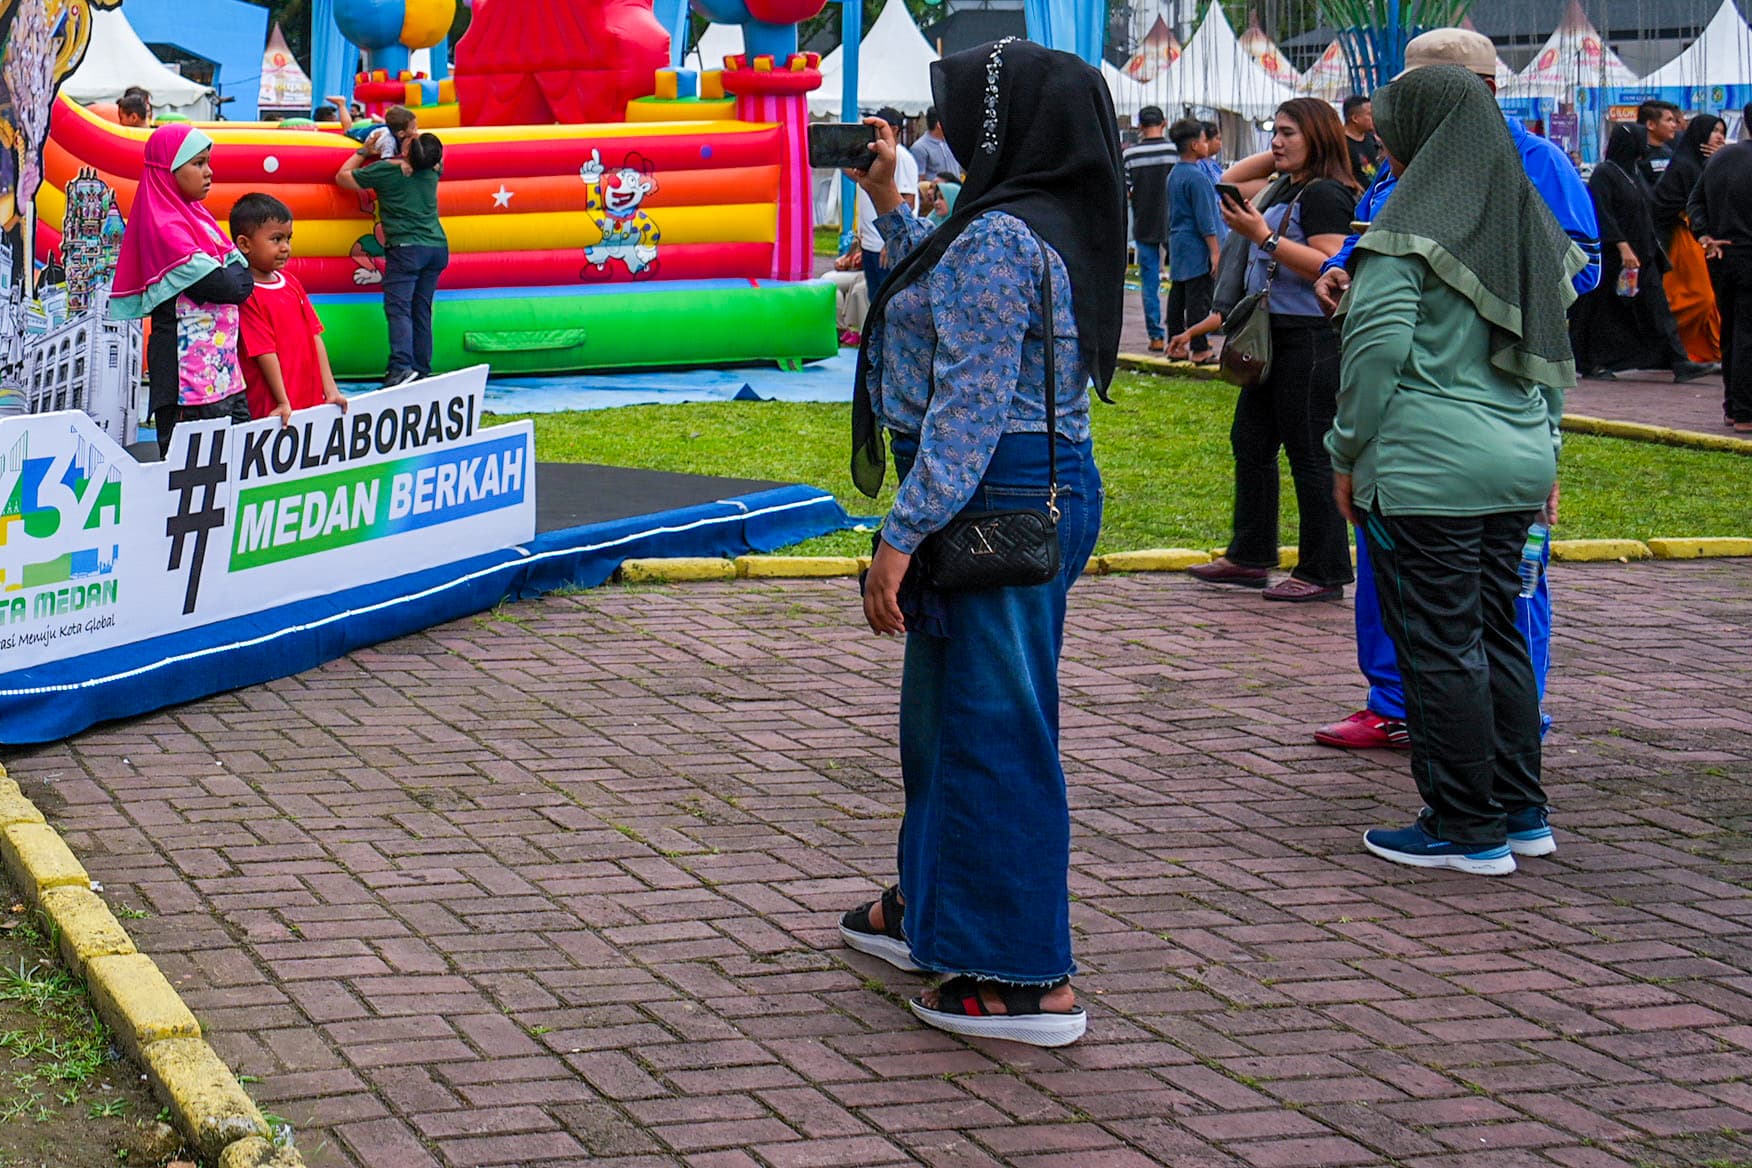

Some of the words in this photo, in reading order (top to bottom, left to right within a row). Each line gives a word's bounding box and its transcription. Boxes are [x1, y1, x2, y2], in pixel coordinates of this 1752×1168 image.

[240, 394, 475, 479] KOLABORASI
[237, 479, 381, 554] MEDAN
[388, 447, 524, 522] BERKAH
[34, 578, 118, 620] MEDAN
[19, 625, 57, 648] Menuju
[59, 624, 83, 638] Kota
[84, 614, 116, 632] Global
